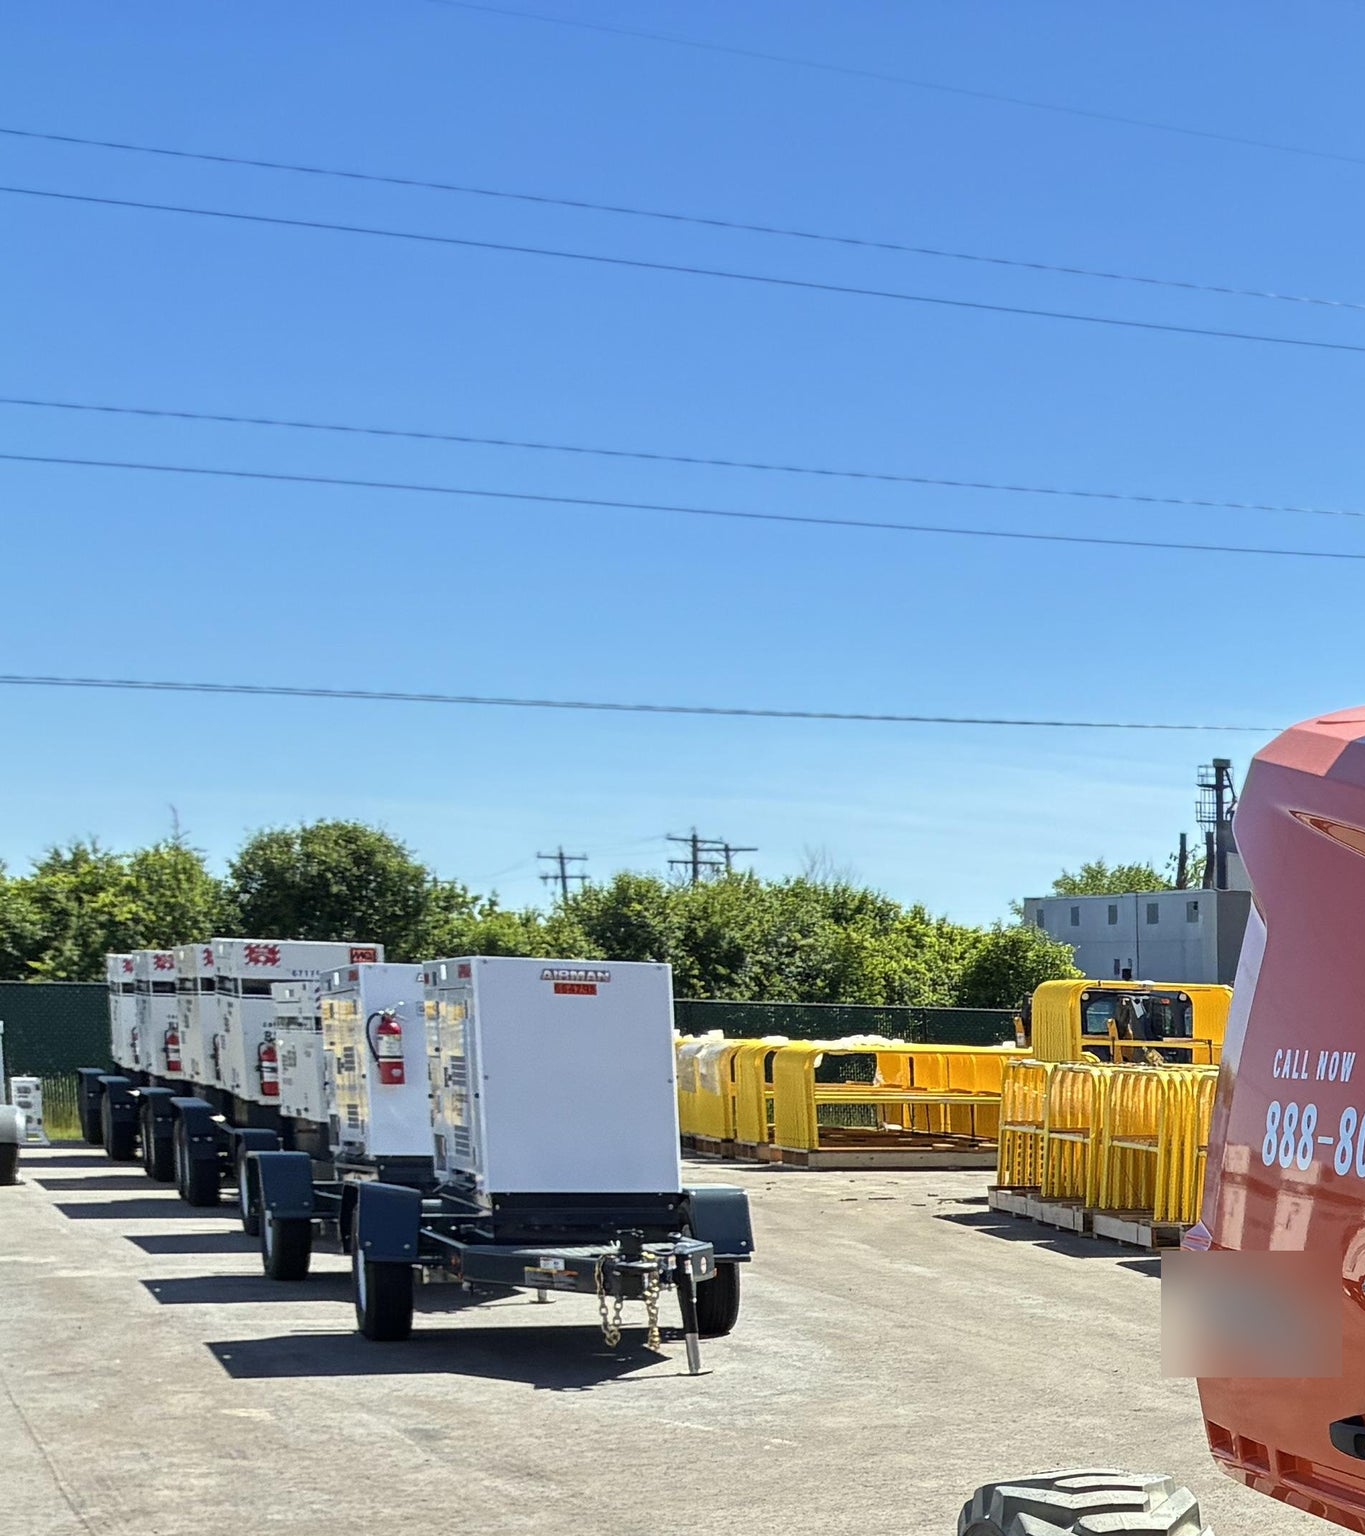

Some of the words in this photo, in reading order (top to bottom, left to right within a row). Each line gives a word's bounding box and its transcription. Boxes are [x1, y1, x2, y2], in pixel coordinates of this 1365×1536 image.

[542, 969, 611, 983] AIRMAN
[1273, 1049, 1309, 1080] CALL
[1316, 1050, 1356, 1083] NOW
